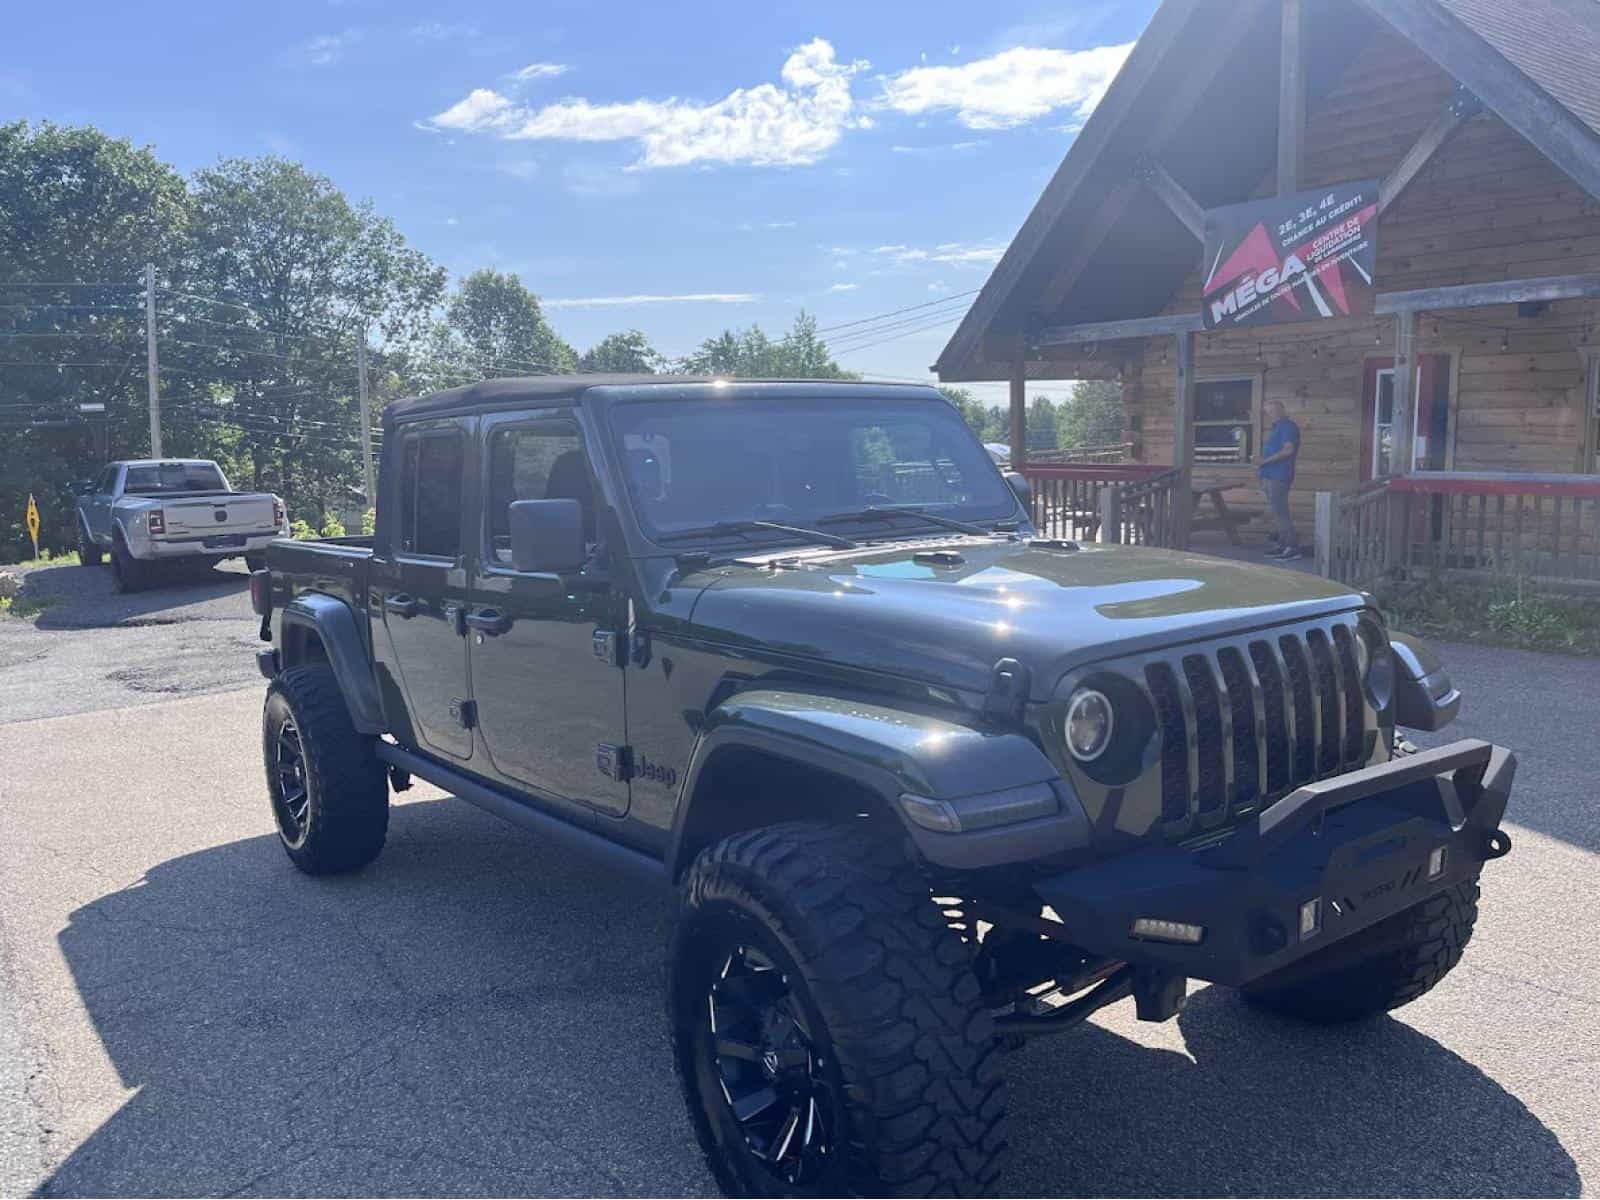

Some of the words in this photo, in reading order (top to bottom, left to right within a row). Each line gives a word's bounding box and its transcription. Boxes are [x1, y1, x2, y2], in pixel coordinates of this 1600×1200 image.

[1279, 220, 1297, 236] 2E,
[1320, 193, 1335, 209] 4E
[1282, 224, 1314, 247] CHANCE
[1315, 215, 1327, 227] AU
[1312, 224, 1346, 249] CENTRE
[1346, 216, 1359, 229] DE
[1306, 224, 1361, 261] LIQUIDATION
[1211, 253, 1307, 324] MÉGA
[638, 754, 677, 790] Jeep
